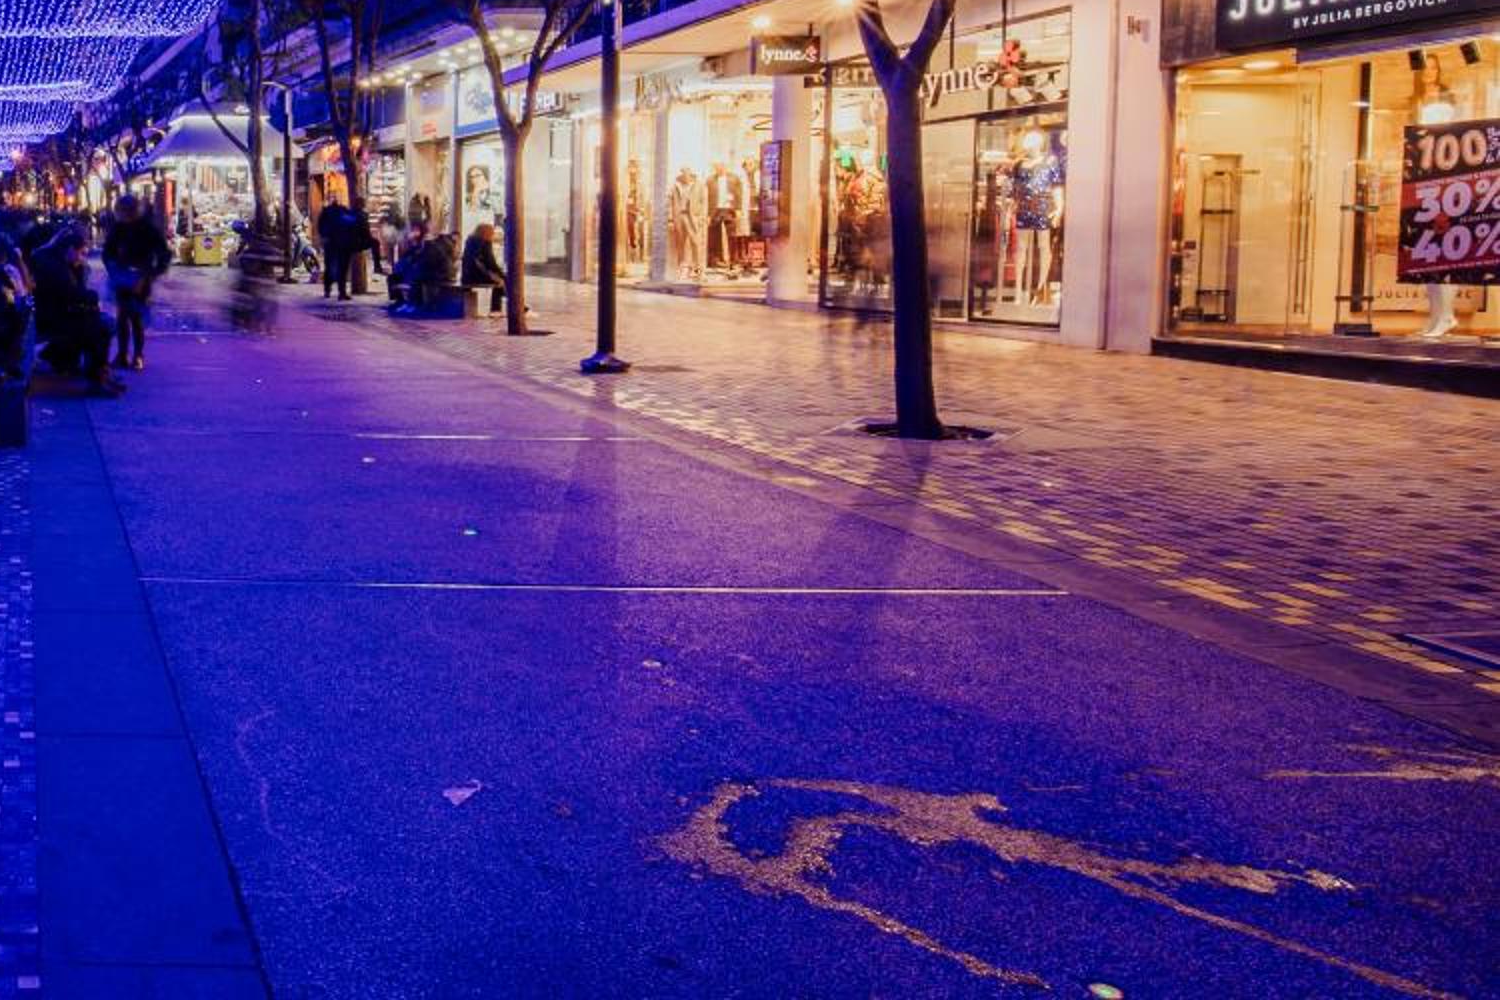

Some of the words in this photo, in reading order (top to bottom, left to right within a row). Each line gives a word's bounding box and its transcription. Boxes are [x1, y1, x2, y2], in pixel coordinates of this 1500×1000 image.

[1292, 16, 1309, 29] BY
[1311, 9, 1351, 26] JULIA
[760, 44, 805, 66] lynne
[1413, 177, 1500, 223] 30%
[1410, 220, 1500, 263] 40%
